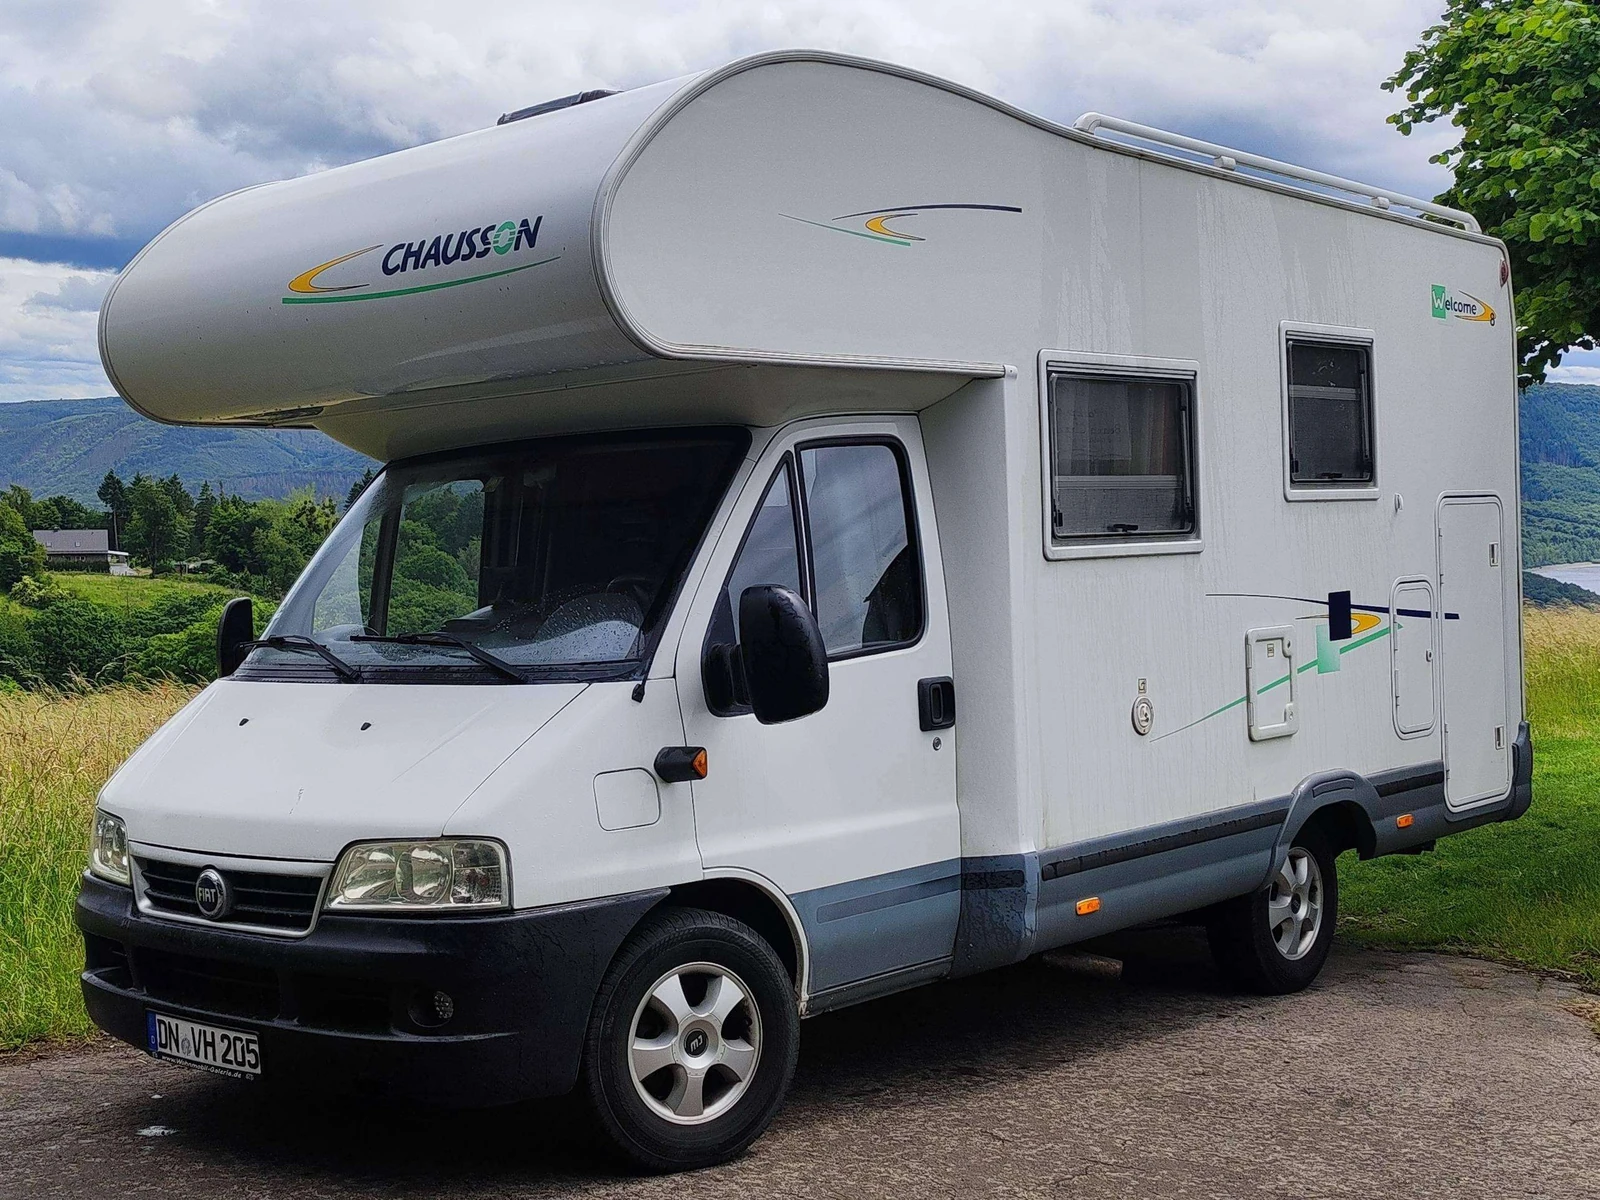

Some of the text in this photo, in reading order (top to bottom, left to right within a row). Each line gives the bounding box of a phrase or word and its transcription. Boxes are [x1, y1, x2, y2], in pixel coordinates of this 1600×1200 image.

[382, 215, 543, 275] CHAUSSON
[1431, 289, 1477, 315] Welcome
[198, 887, 216, 903] FIAT
[157, 1019, 260, 1070] DN VH 205
